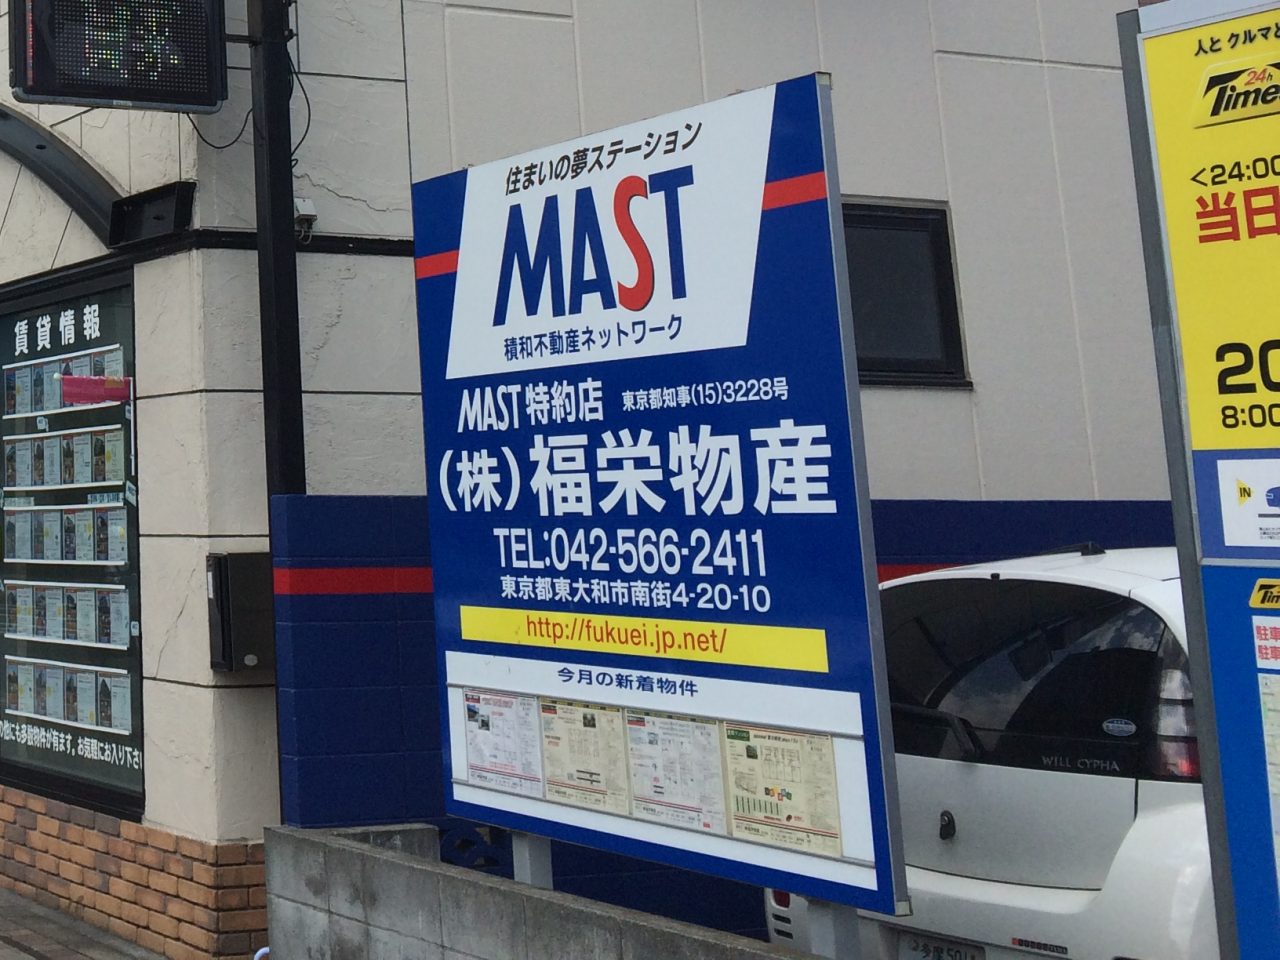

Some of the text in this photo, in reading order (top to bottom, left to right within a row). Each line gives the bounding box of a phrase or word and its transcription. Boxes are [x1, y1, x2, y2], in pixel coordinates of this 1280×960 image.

[505, 121, 703, 197] 住まいの夢ステーション
[492, 164, 695, 327] MAST
[13, 303, 101, 357] 賃貸情報
[503, 313, 683, 363] 積和不動産ネットワーク
[457, 377, 604, 433] MAST 特約店
[621, 376, 789, 413] 東京都知事(15)3228号
[438, 418, 838, 517] (株)福栄物産
[1239, 487, 1252, 498] IN
[500, 574, 771, 613] 東京都東大和市南街4-20-10
[525, 614, 727, 655] http://fukuei.jp.net/
[557, 666, 699, 698] 今月の新着物件
[1041, 755, 1121, 773] WILL CYPHA
